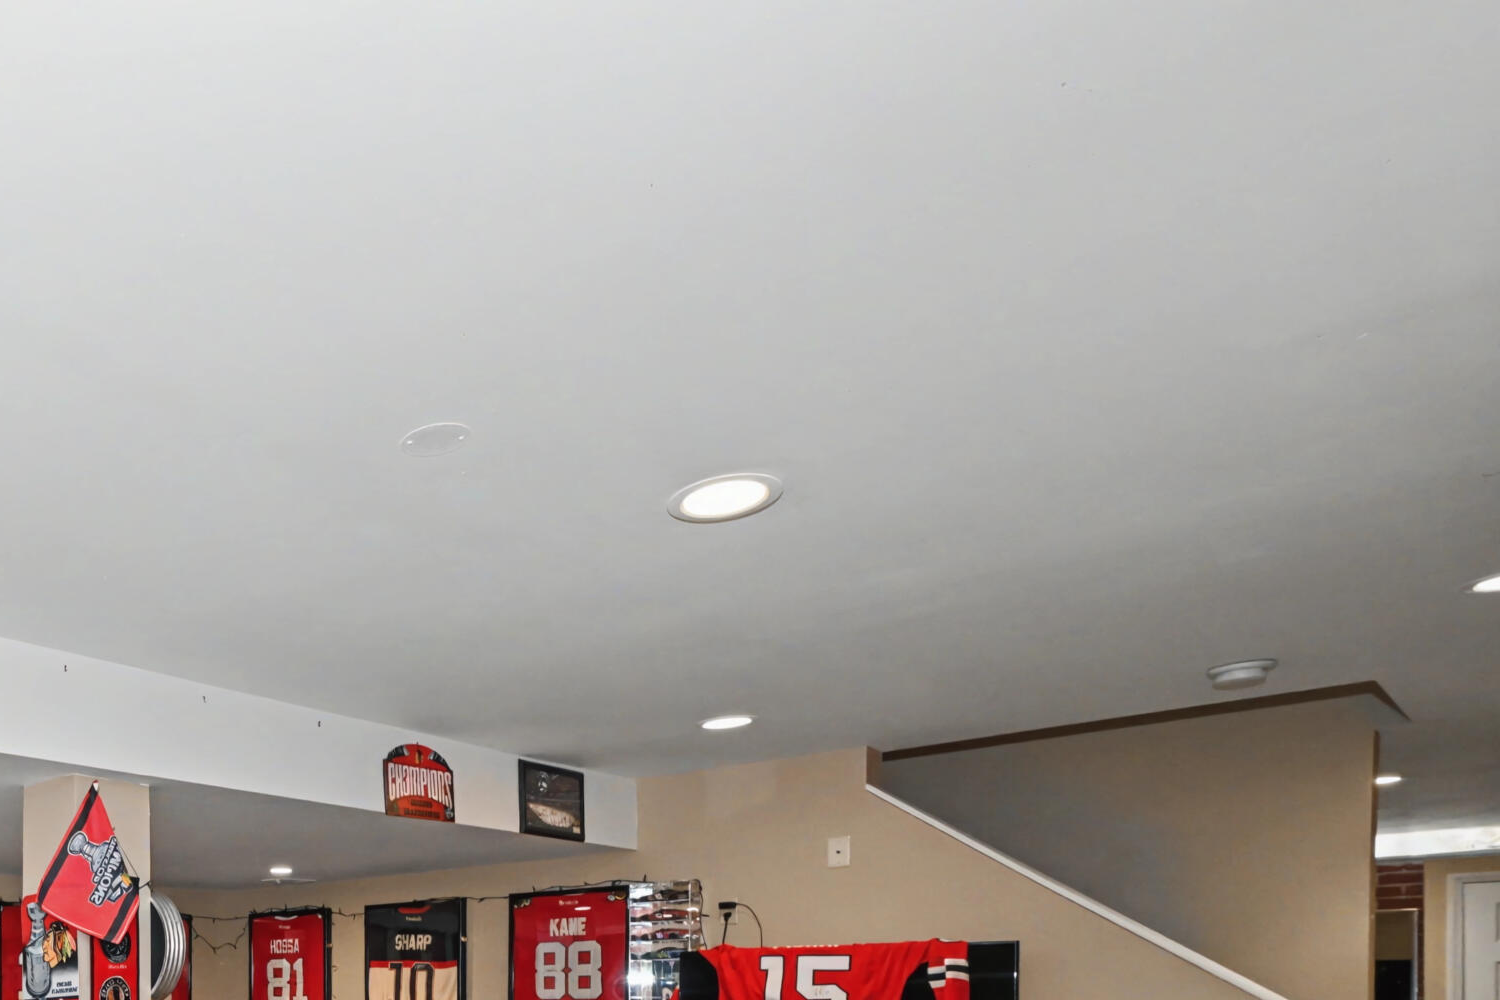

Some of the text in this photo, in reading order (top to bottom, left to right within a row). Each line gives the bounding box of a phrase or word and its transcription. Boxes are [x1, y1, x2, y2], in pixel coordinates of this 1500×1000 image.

[549, 916, 587, 937] KANE
[270, 938, 300, 954] HOSSA
[395, 933, 432, 951] SHARP
[534, 940, 603, 1000] 88
